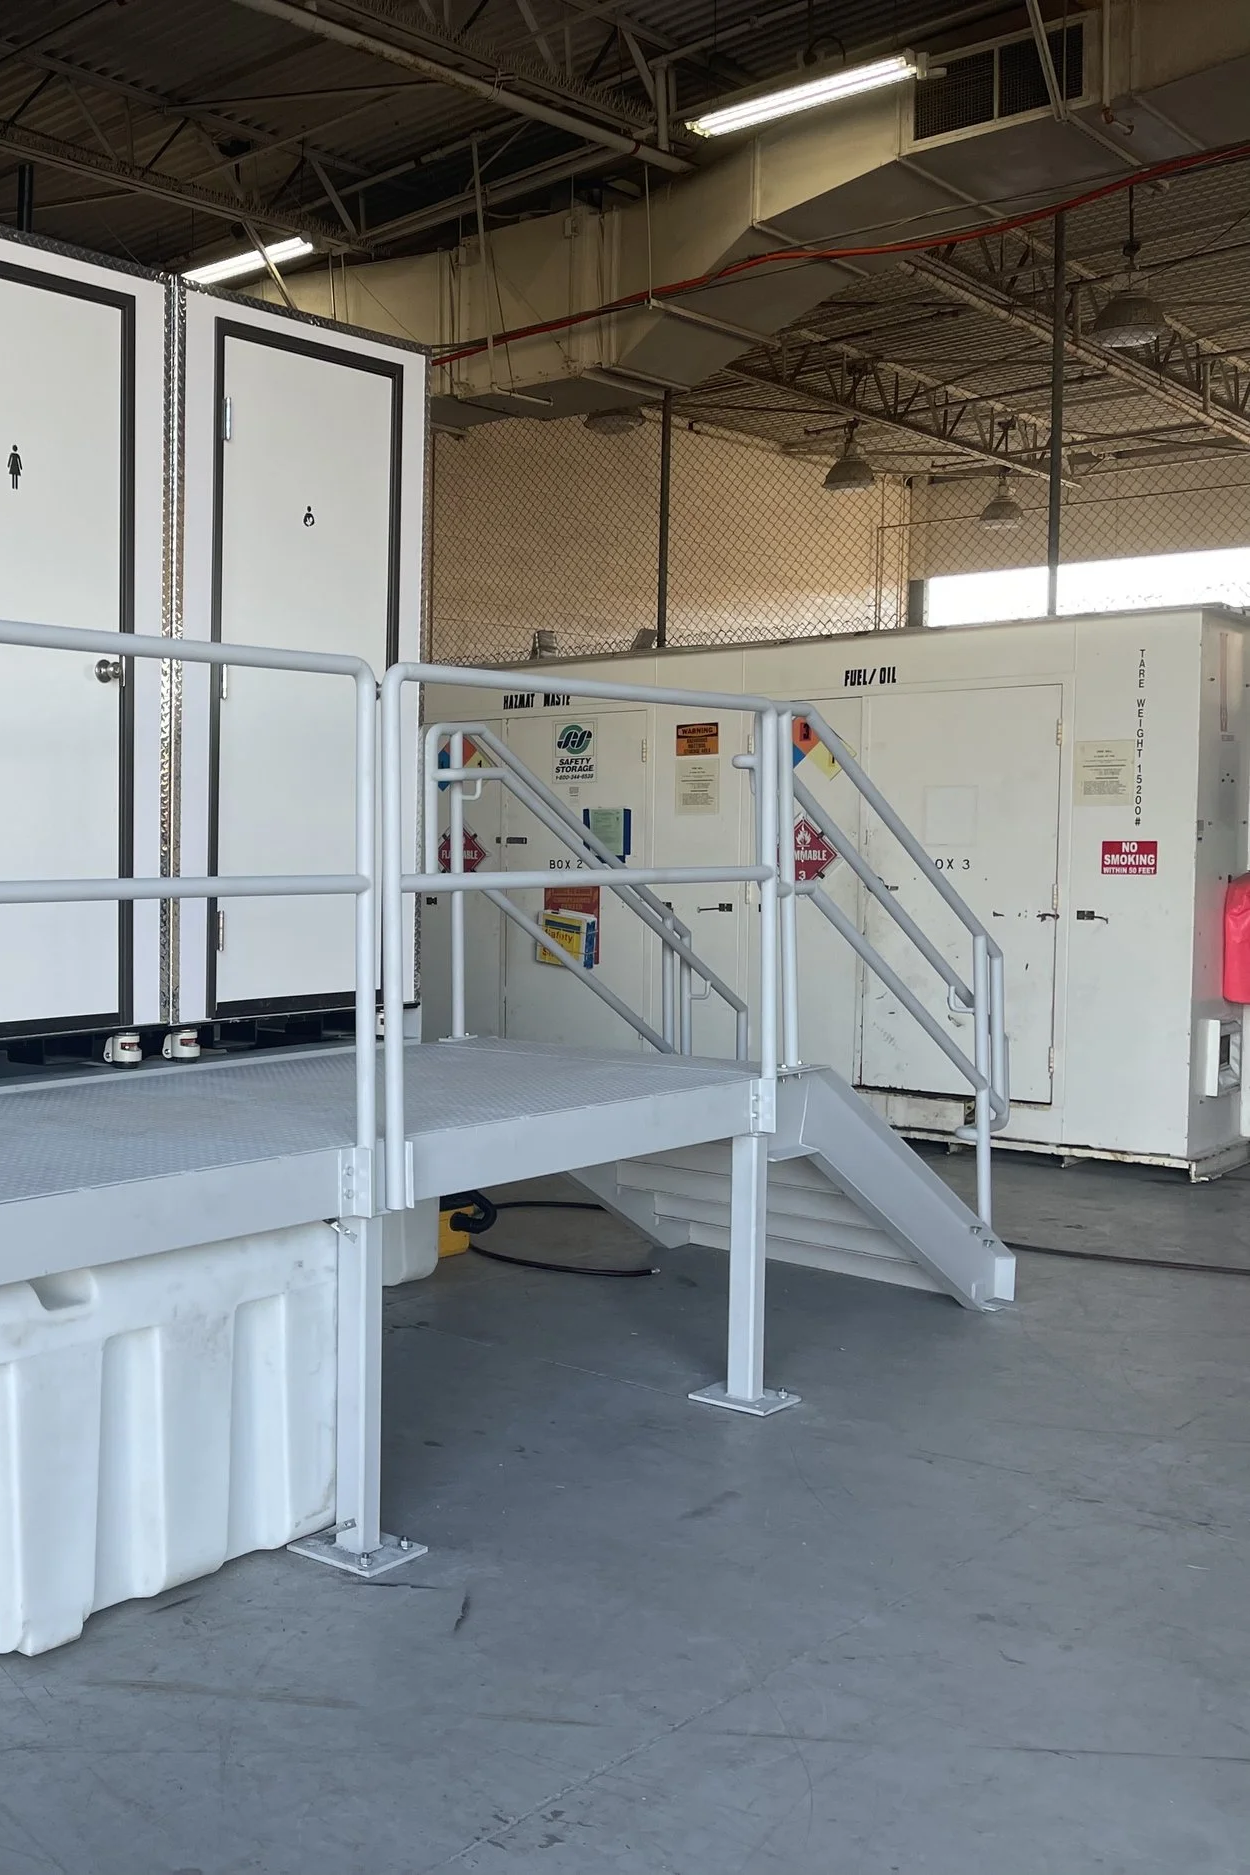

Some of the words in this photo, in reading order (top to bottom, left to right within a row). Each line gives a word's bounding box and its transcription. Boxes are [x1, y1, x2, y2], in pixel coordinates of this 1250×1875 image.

[1138, 648, 1146, 688] TARE
[503, 693, 535, 710] HAZMAT
[543, 693, 571, 707] WASTE
[681, 727, 714, 735] WARNING
[1136, 698, 1146, 758] WEIGHT
[559, 757, 592, 766] SAFETY
[555, 764, 594, 773] STORAGE
[1134, 764, 1143, 826] 15200#
[1121, 841, 1138, 853] NO
[441, 849, 479, 860] FLABLE
[794, 849, 827, 861] MMABLE
[1103, 854, 1156, 866] SMOKING
[549, 859, 571, 870] BOX
[576, 859, 583, 869] 2
[935, 858, 954, 870] OX
[962, 859, 970, 870] 3
[1103, 866, 1128, 874] WITHIN
[1128, 866, 1137, 874] 50
[1138, 866, 1155, 874] FEET
[798, 870, 806, 880] 3
